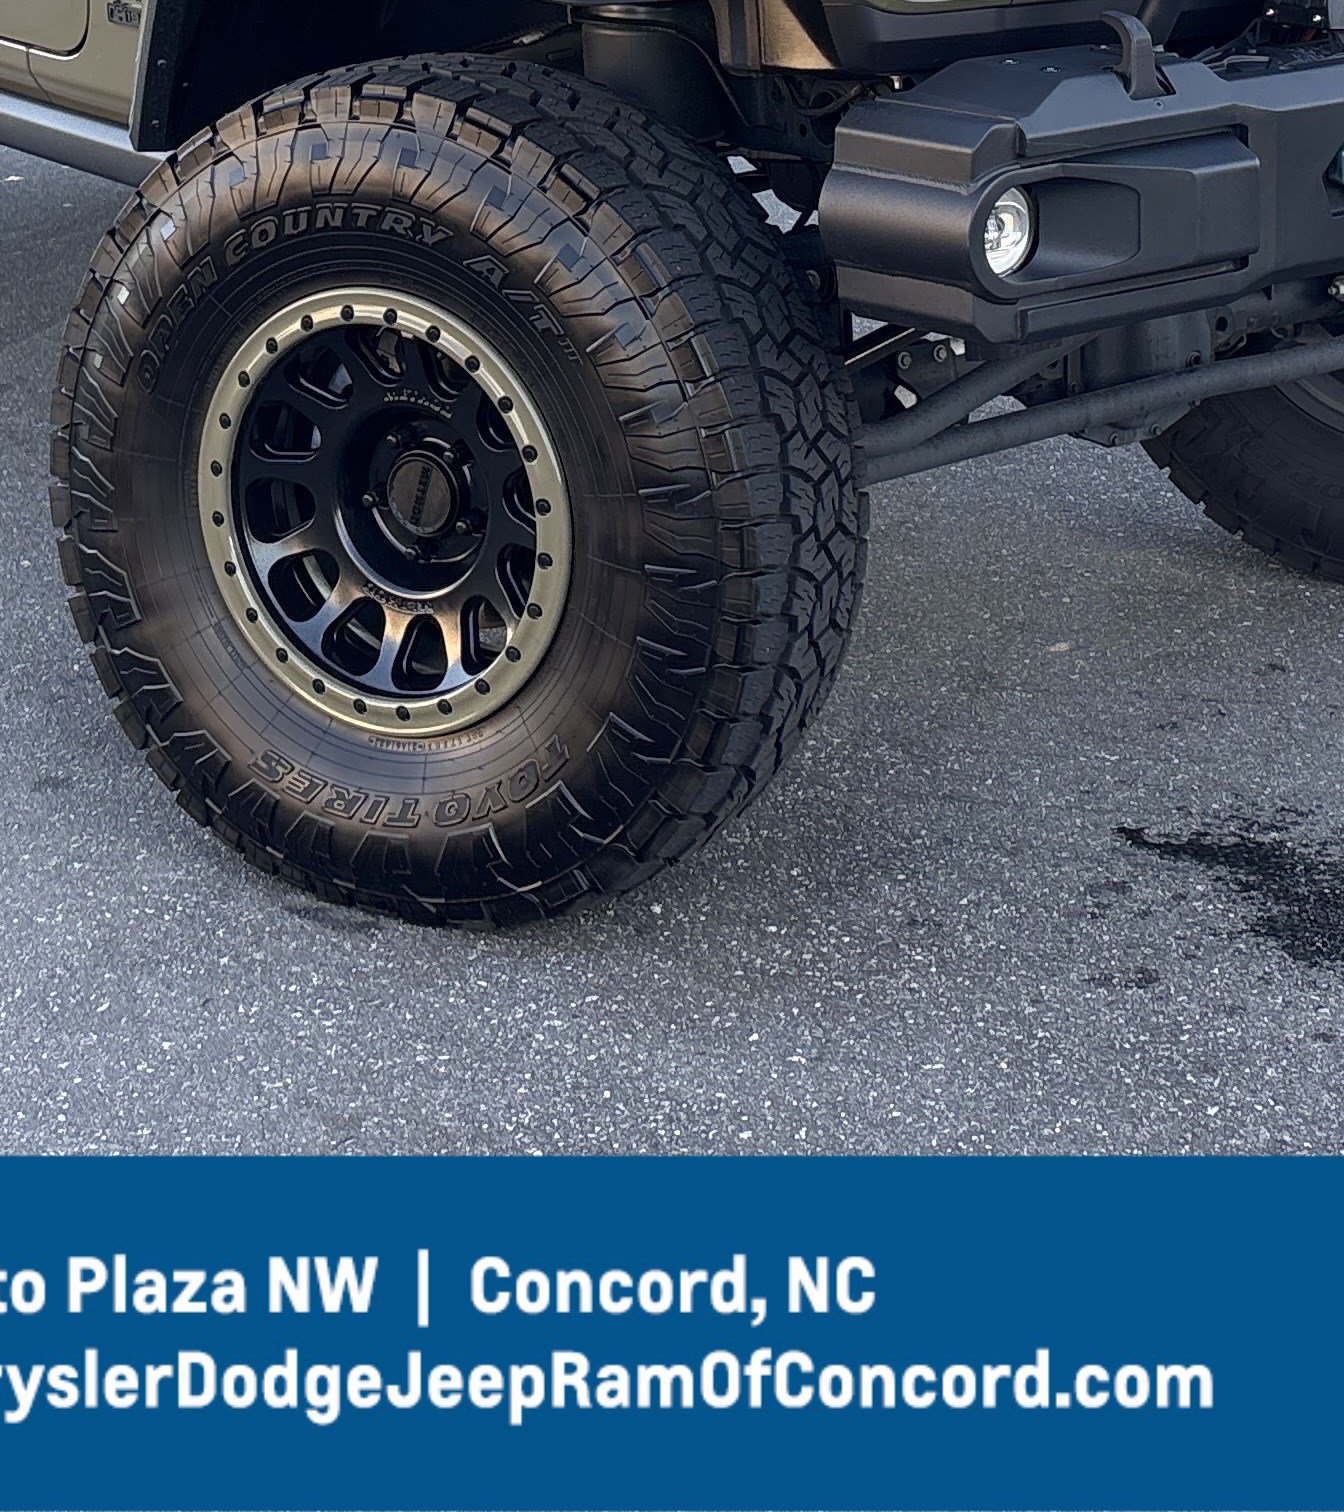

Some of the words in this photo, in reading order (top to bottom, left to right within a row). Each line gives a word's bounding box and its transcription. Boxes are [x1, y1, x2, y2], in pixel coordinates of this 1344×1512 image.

[139, 255, 219, 392] OPEN
[224, 202, 455, 267] COUNTRY
[462, 253, 564, 338] A/T
[247, 748, 423, 829] TIRES
[433, 735, 571, 828] TOYO
